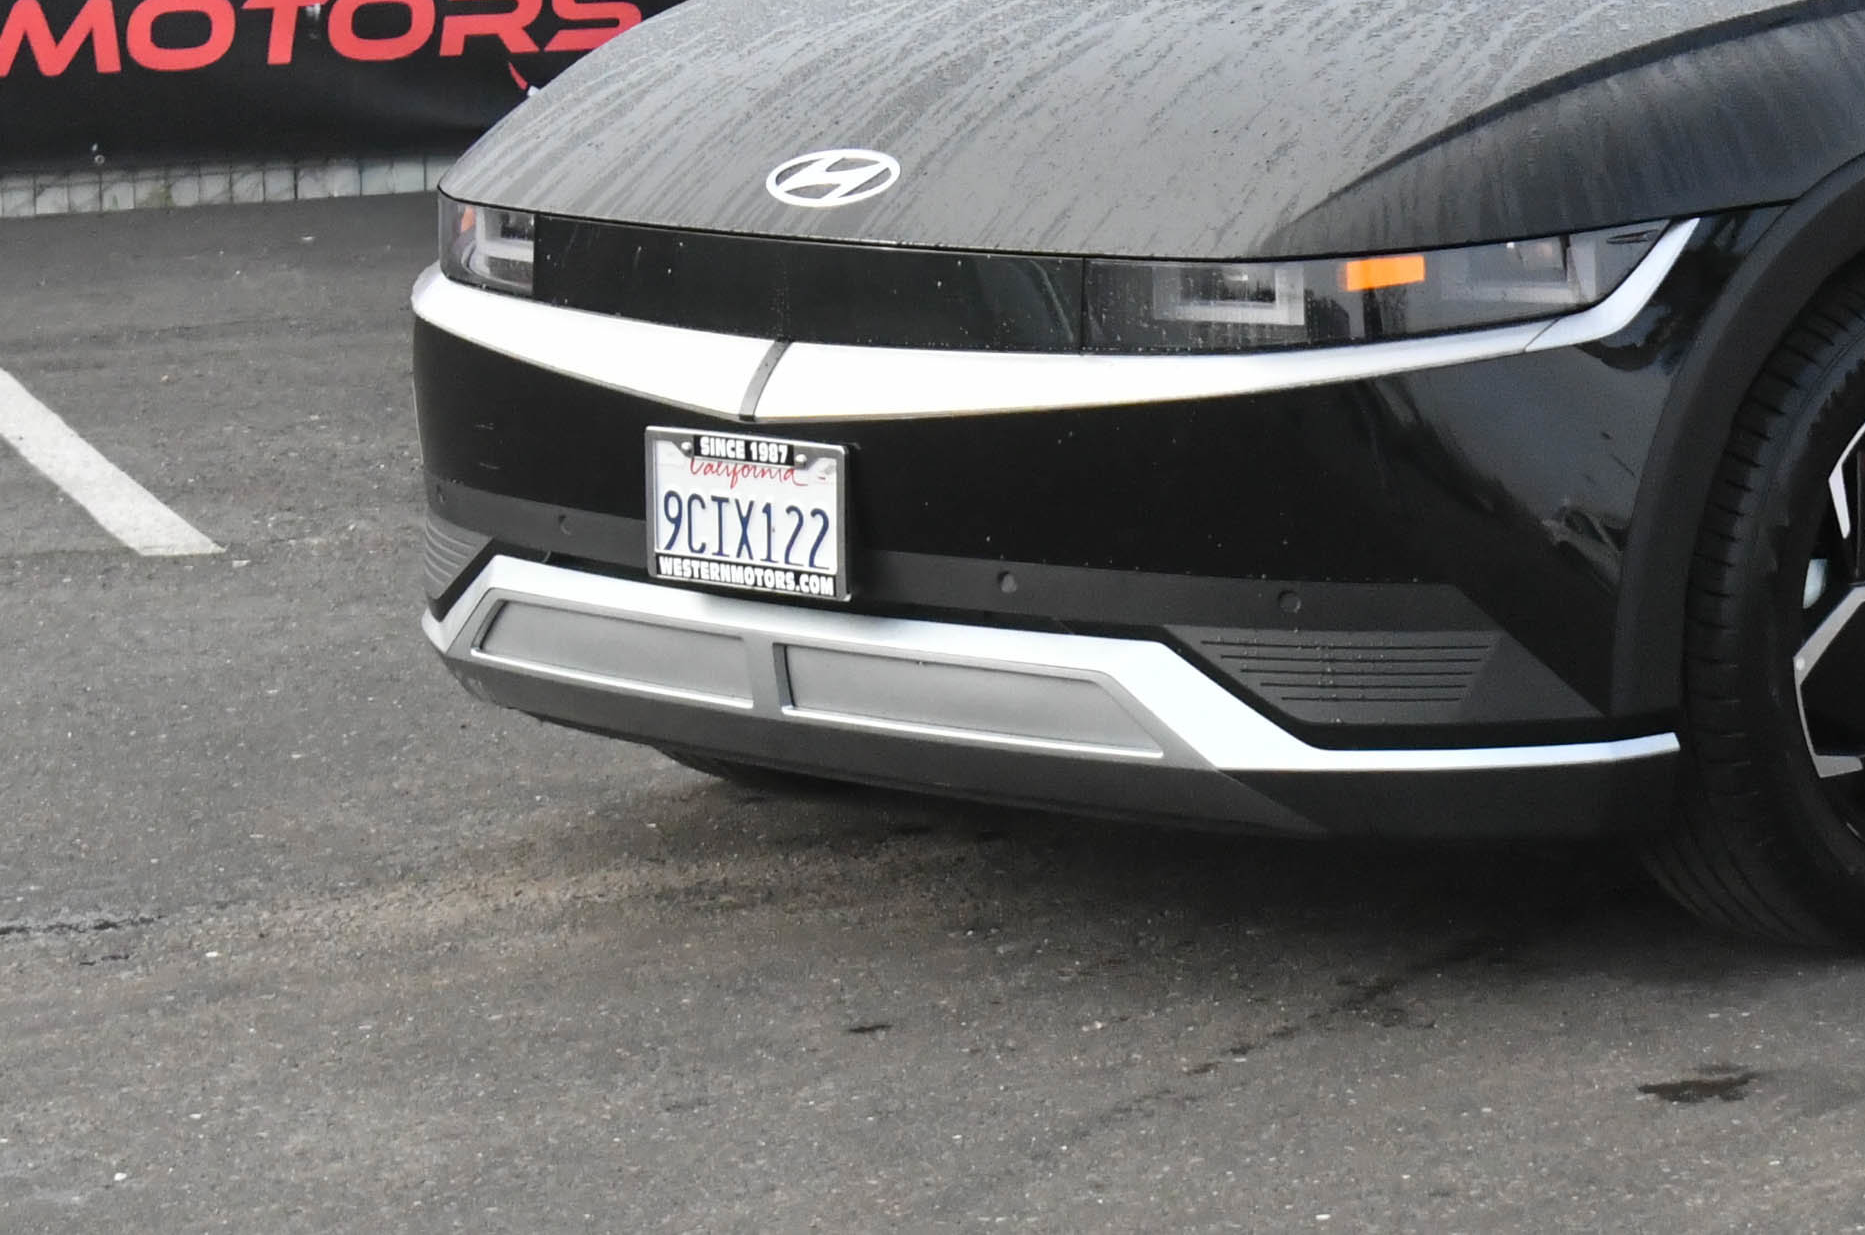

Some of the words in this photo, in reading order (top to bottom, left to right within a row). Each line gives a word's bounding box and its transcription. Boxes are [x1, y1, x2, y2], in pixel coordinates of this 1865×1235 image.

[700, 436, 745, 460] SINCE
[750, 441, 788, 464] 1987
[658, 555, 834, 597] WESTERNMOTORS.COM
